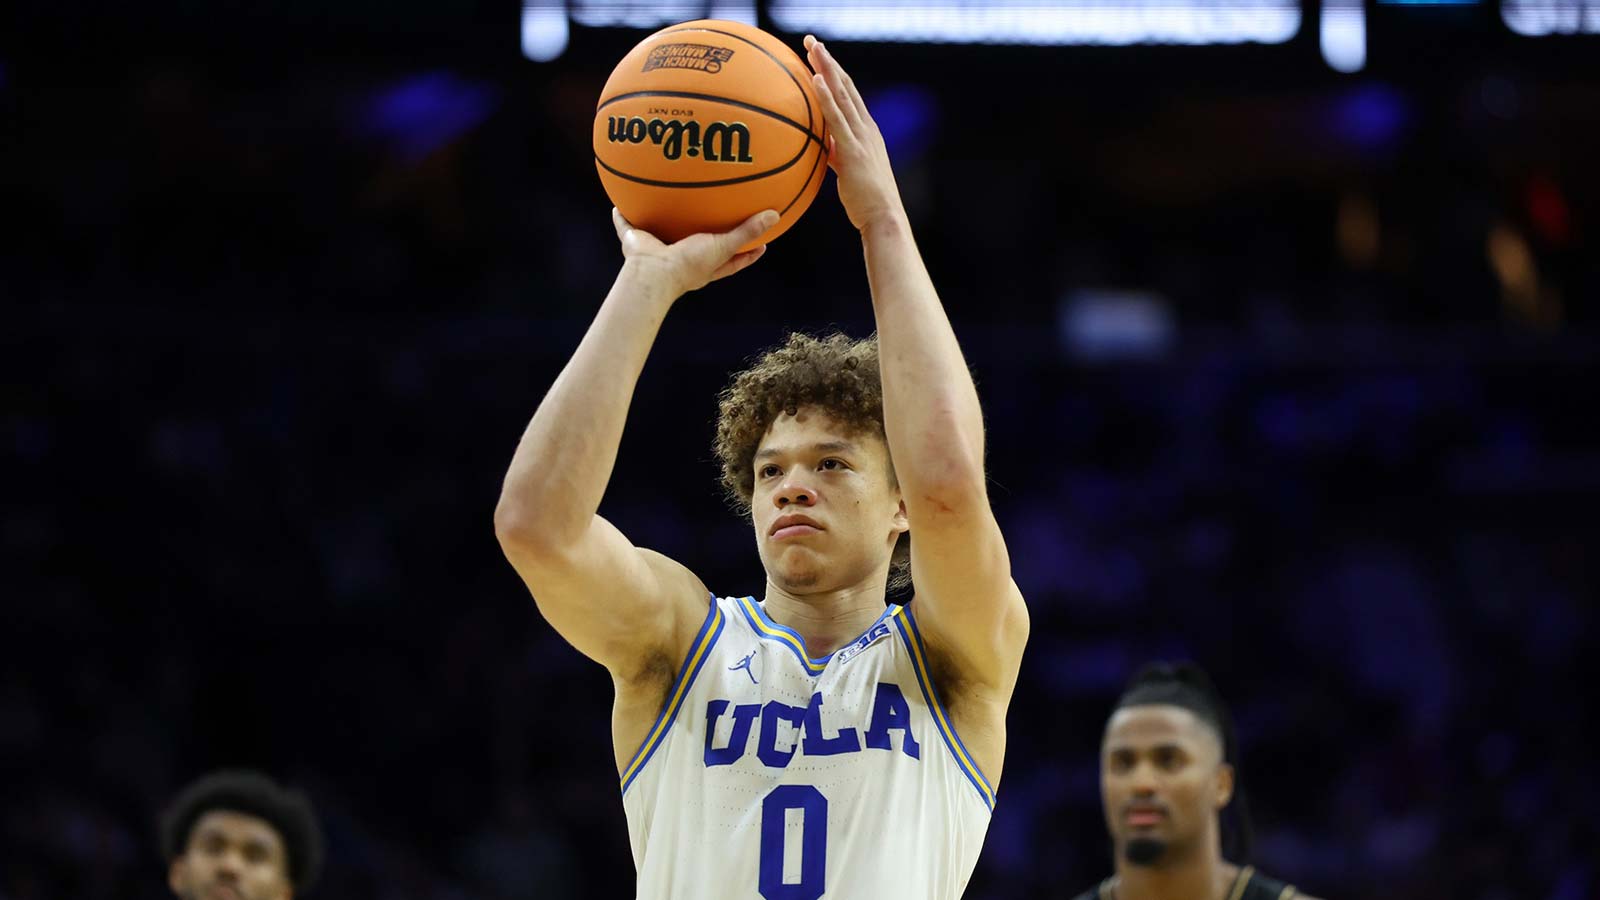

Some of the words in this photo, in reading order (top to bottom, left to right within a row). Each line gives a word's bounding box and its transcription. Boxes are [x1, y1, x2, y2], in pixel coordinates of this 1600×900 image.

[652, 46, 708, 59] MADNESS
[662, 57, 707, 70] MARCH
[648, 107, 669, 116] NXT
[671, 108, 694, 117] EVO
[607, 115, 753, 164] Wilson
[703, 682, 920, 768] UCLA
[758, 785, 828, 900] 0
